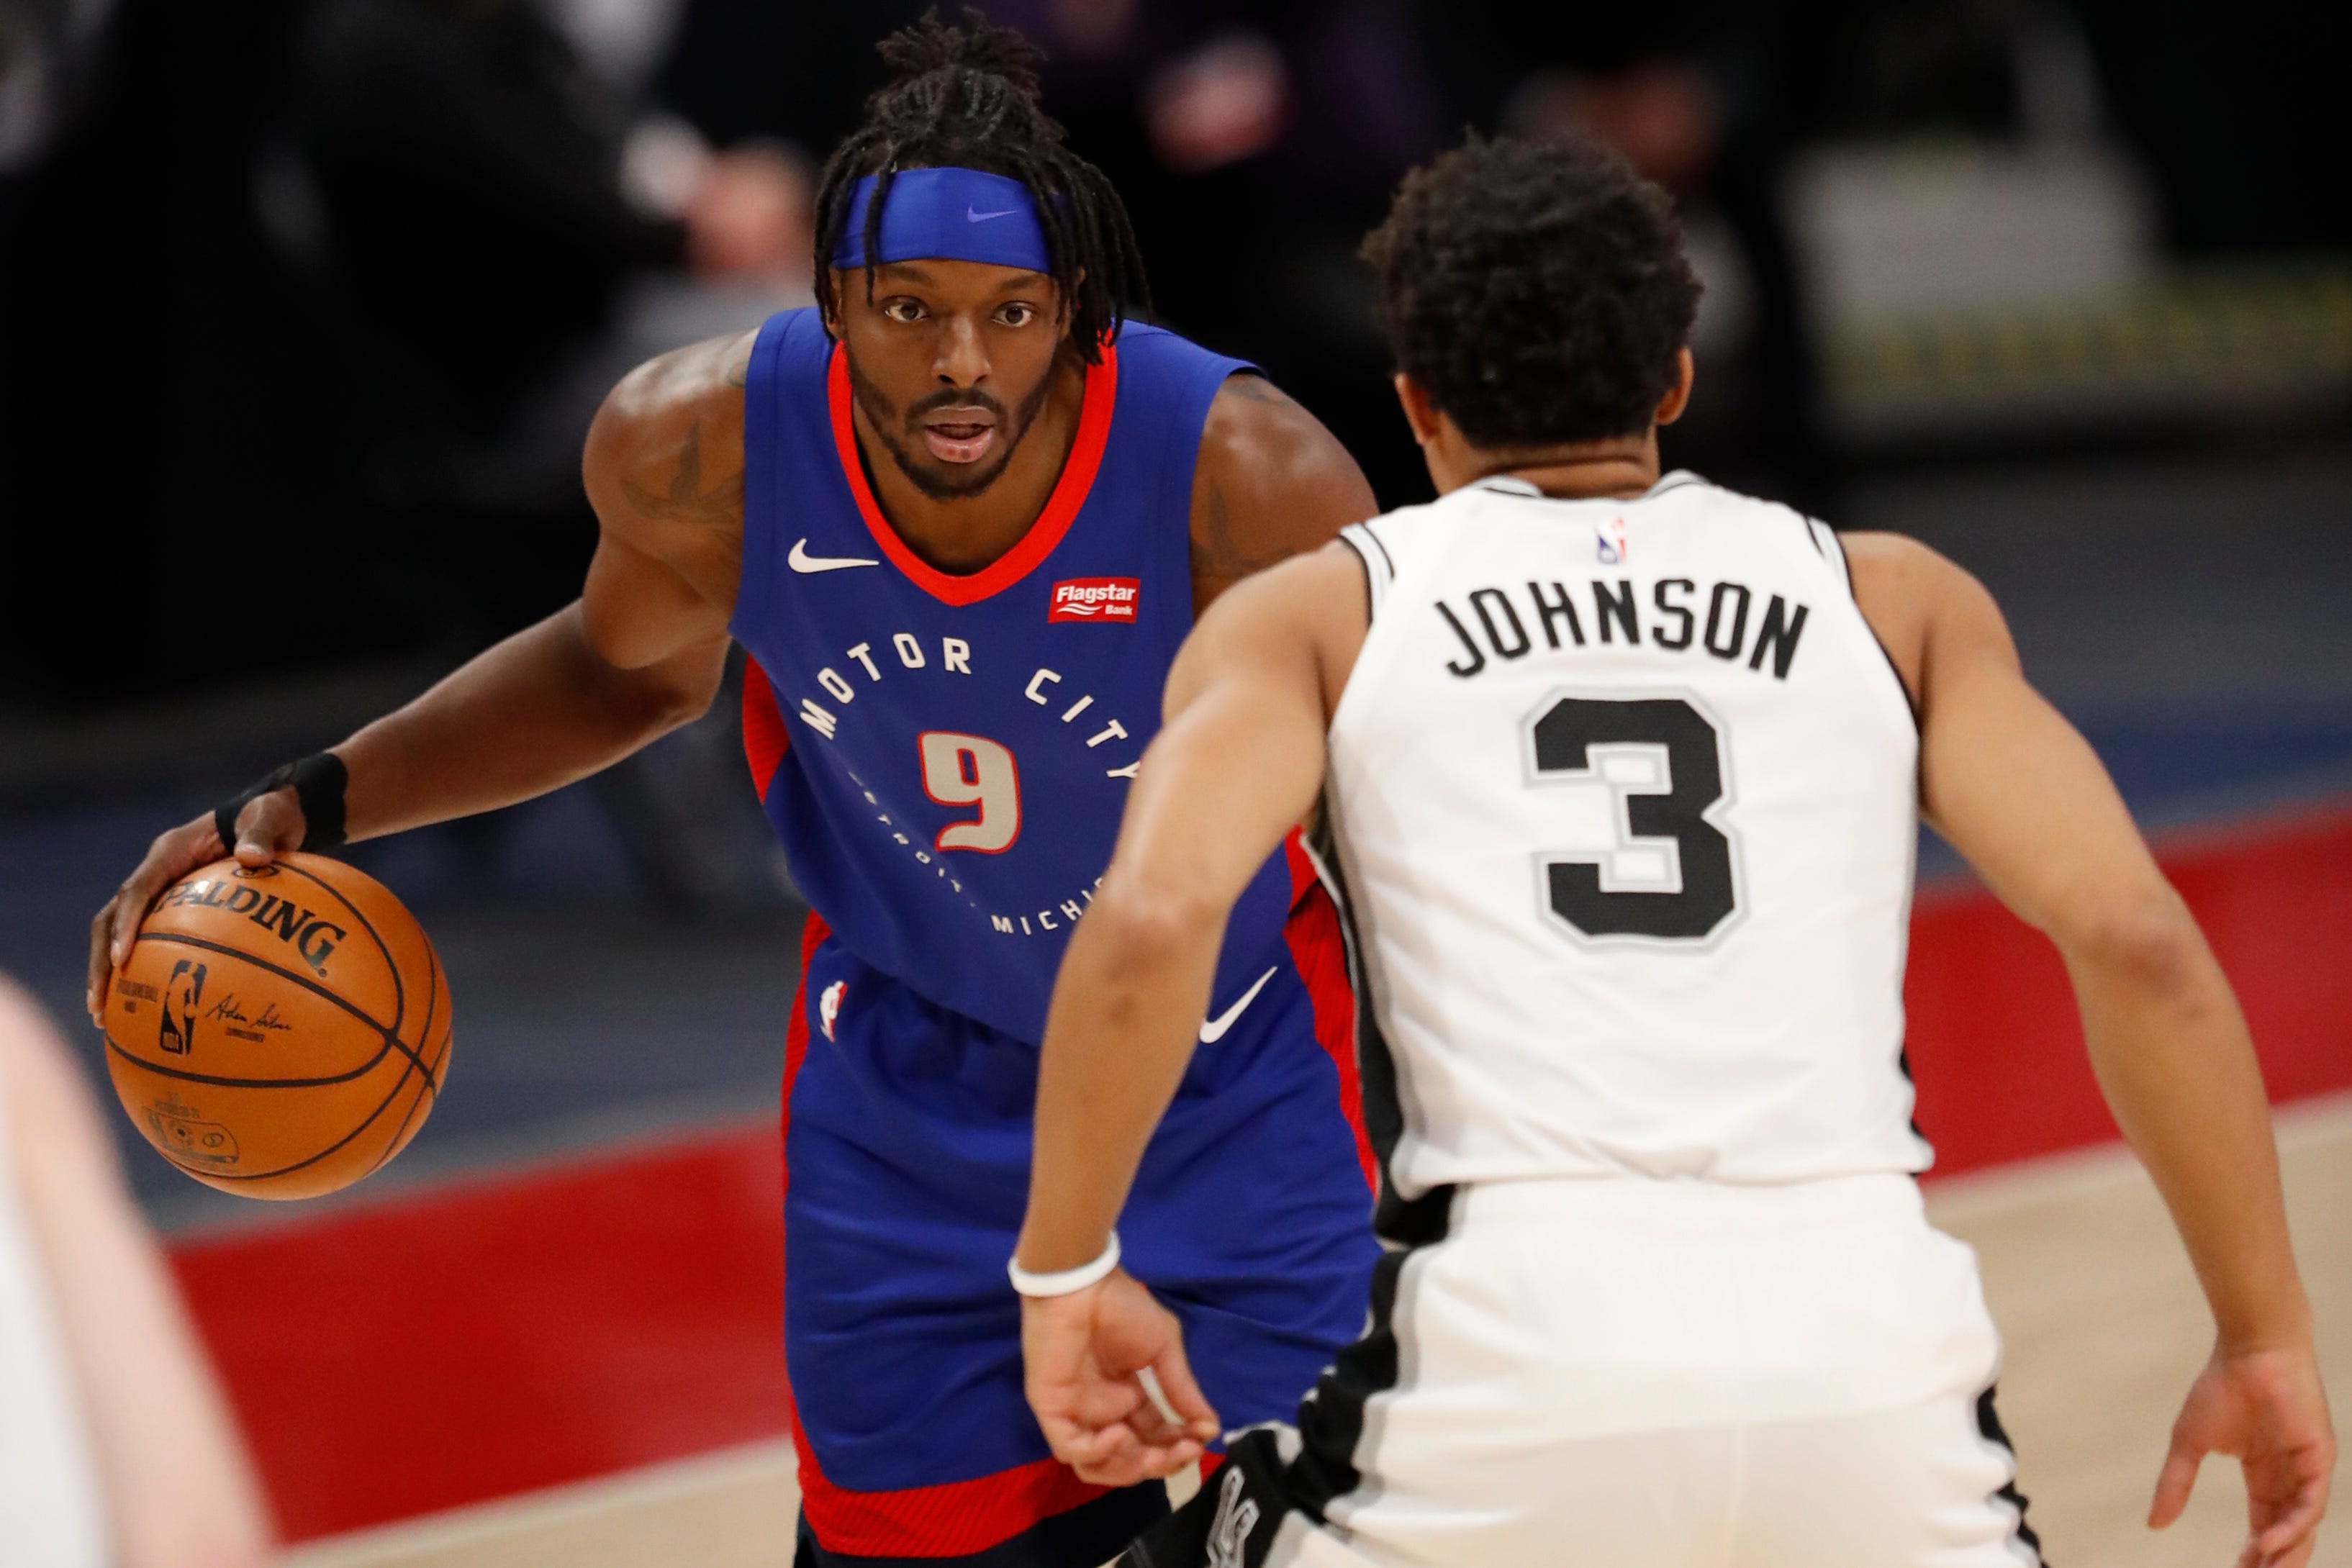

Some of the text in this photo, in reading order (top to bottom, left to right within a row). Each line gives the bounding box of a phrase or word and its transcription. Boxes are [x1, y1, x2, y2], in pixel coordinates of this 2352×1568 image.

[1056, 584, 1136, 604] Flagstar
[1105, 604, 1133, 616] Bank
[1435, 579, 1809, 680] JOHNSON
[800, 633, 1141, 778] MOTOR CITY
[918, 730, 1023, 855] 9
[1517, 687, 1751, 953] 3
